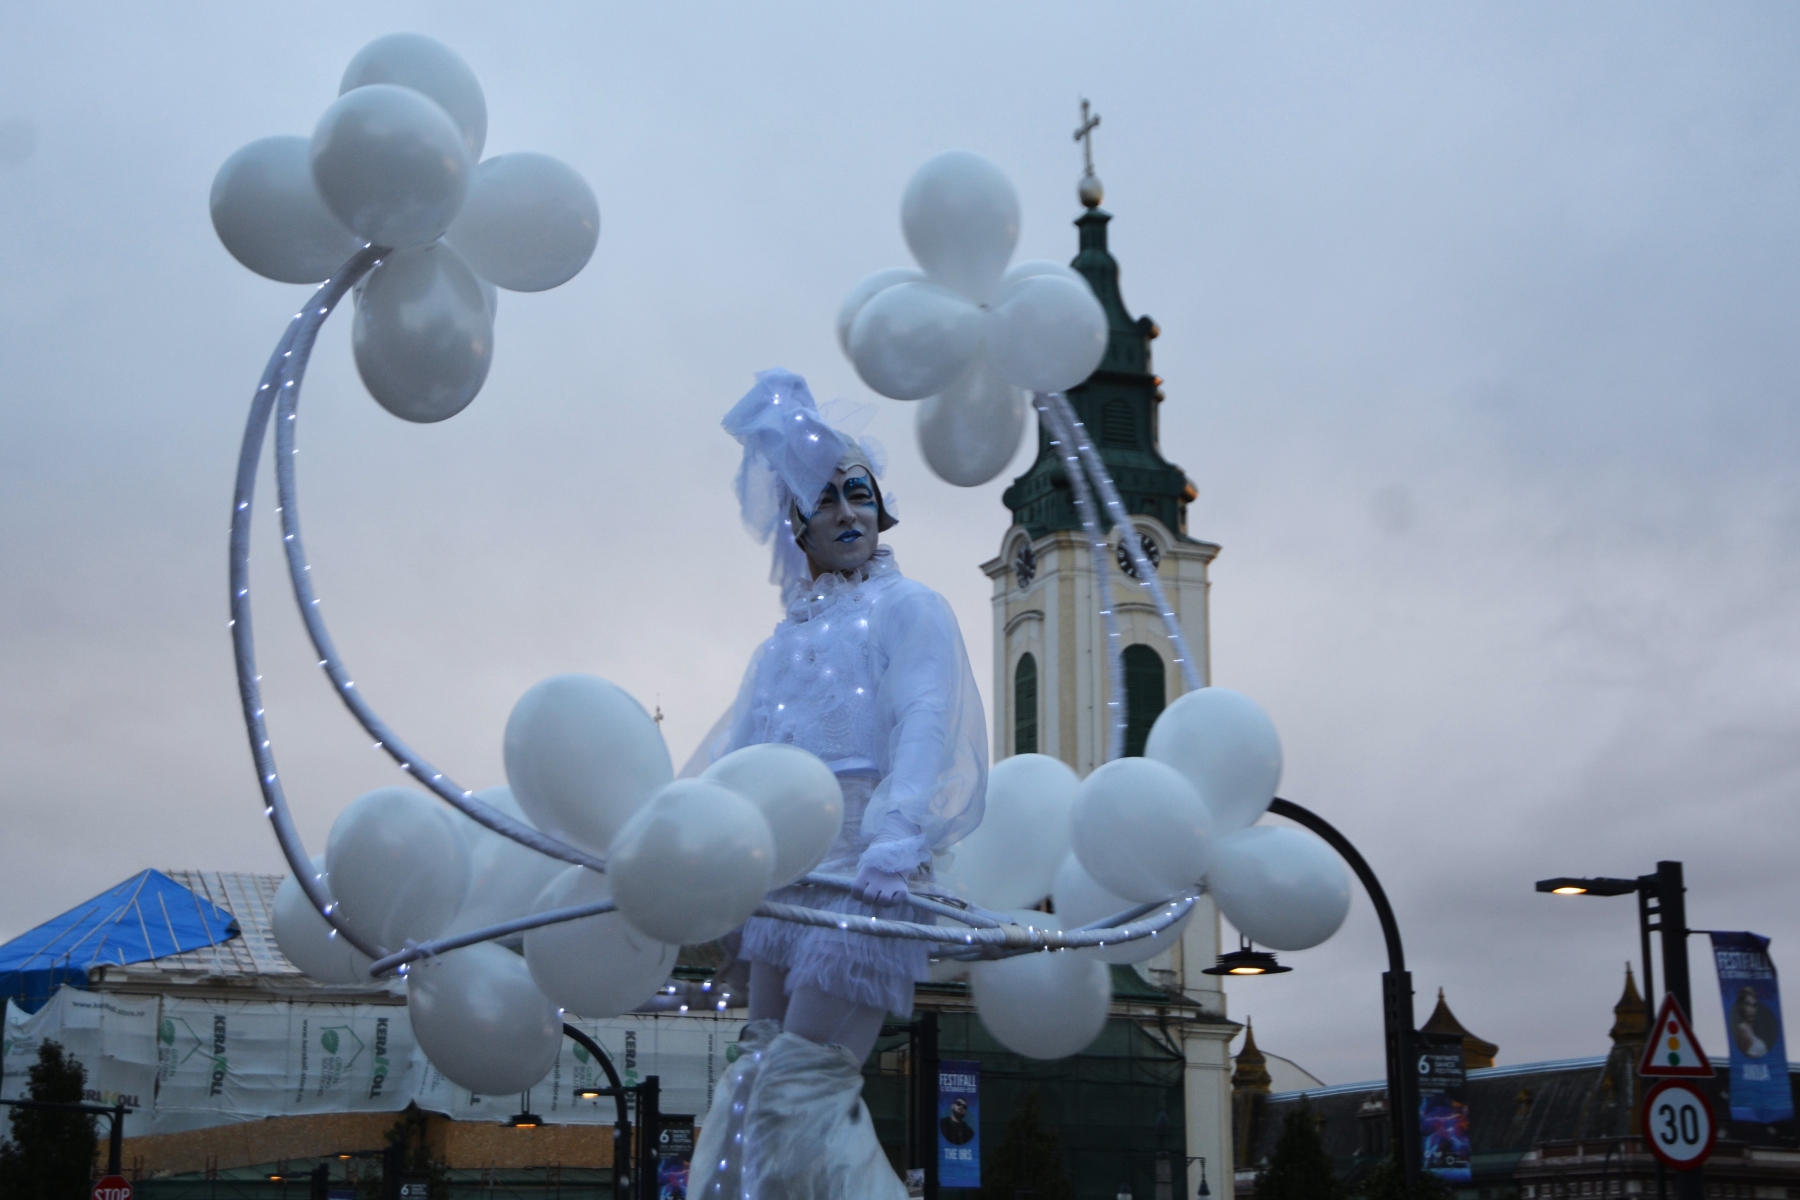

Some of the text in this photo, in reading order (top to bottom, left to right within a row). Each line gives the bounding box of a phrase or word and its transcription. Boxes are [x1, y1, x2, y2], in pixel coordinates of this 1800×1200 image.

[210, 1015, 228, 1097] KERAKOLL
[370, 1017, 390, 1099] KERAKOLL
[939, 1074, 977, 1086] FESTIFALL
[1658, 1104, 1699, 1145] 30
[944, 1148, 957, 1160] THE
[94, 1187, 131, 1200] STOP
